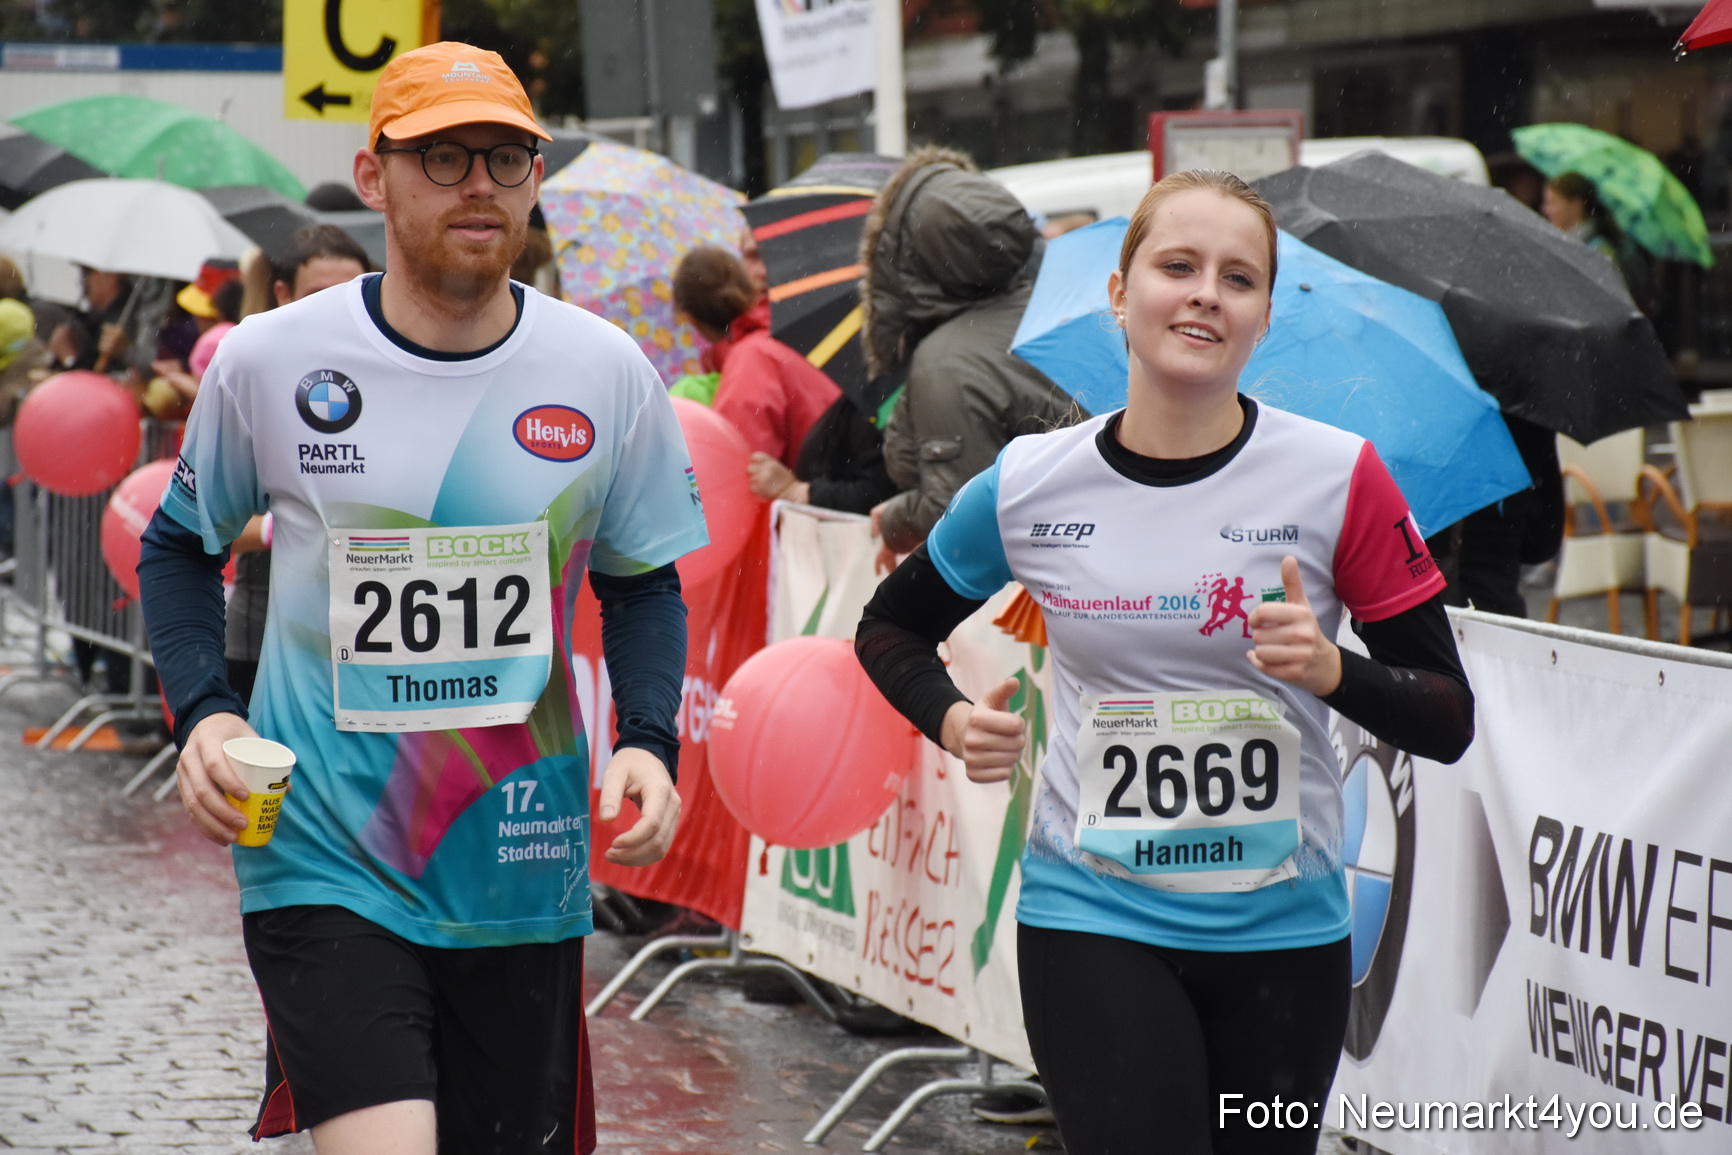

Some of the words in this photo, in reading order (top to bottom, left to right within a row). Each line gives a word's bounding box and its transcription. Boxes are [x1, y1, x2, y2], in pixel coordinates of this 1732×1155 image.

[323, 0, 398, 72] C
[441, 71, 491, 81] MOUNTAIN
[300, 370, 356, 393] BMW
[525, 417, 587, 447] Hervis
[298, 444, 365, 460] PARTL
[530, 441, 562, 450] SPORTS
[300, 461, 365, 474] Neumarkt
[1050, 523, 1095, 541] cep
[1231, 528, 1298, 542] STURM
[427, 532, 530, 559] BOCK
[346, 553, 414, 564] NeuerMarkt
[426, 560, 459, 568] inspired
[473, 558, 496, 566] smart
[499, 556, 532, 566] concepts
[1042, 590, 1152, 611] Mainauenlauf
[1158, 595, 1201, 611] 2016
[354, 574, 531, 653] 2612
[1073, 612, 1090, 620] ZUR
[1091, 612, 1201, 620] LANDESGARTENSCHAU
[386, 675, 498, 703] Thomas
[1171, 698, 1280, 724] BOCK
[1092, 717, 1159, 728] NeuerMarkt
[1171, 725, 1204, 734] inspired
[1206, 725, 1217, 733] by
[1219, 723, 1243, 731] smart
[1244, 722, 1282, 731] concepts
[1103, 738, 1279, 819] 2669
[261, 797, 280, 806] AUS
[501, 780, 545, 815] 17.
[1087, 814, 1096, 826] D
[1135, 835, 1243, 867] Hannah
[1528, 814, 1659, 968] BMW
[1525, 977, 1667, 1102] WENIGER
[1674, 1026, 1732, 1125] VE
